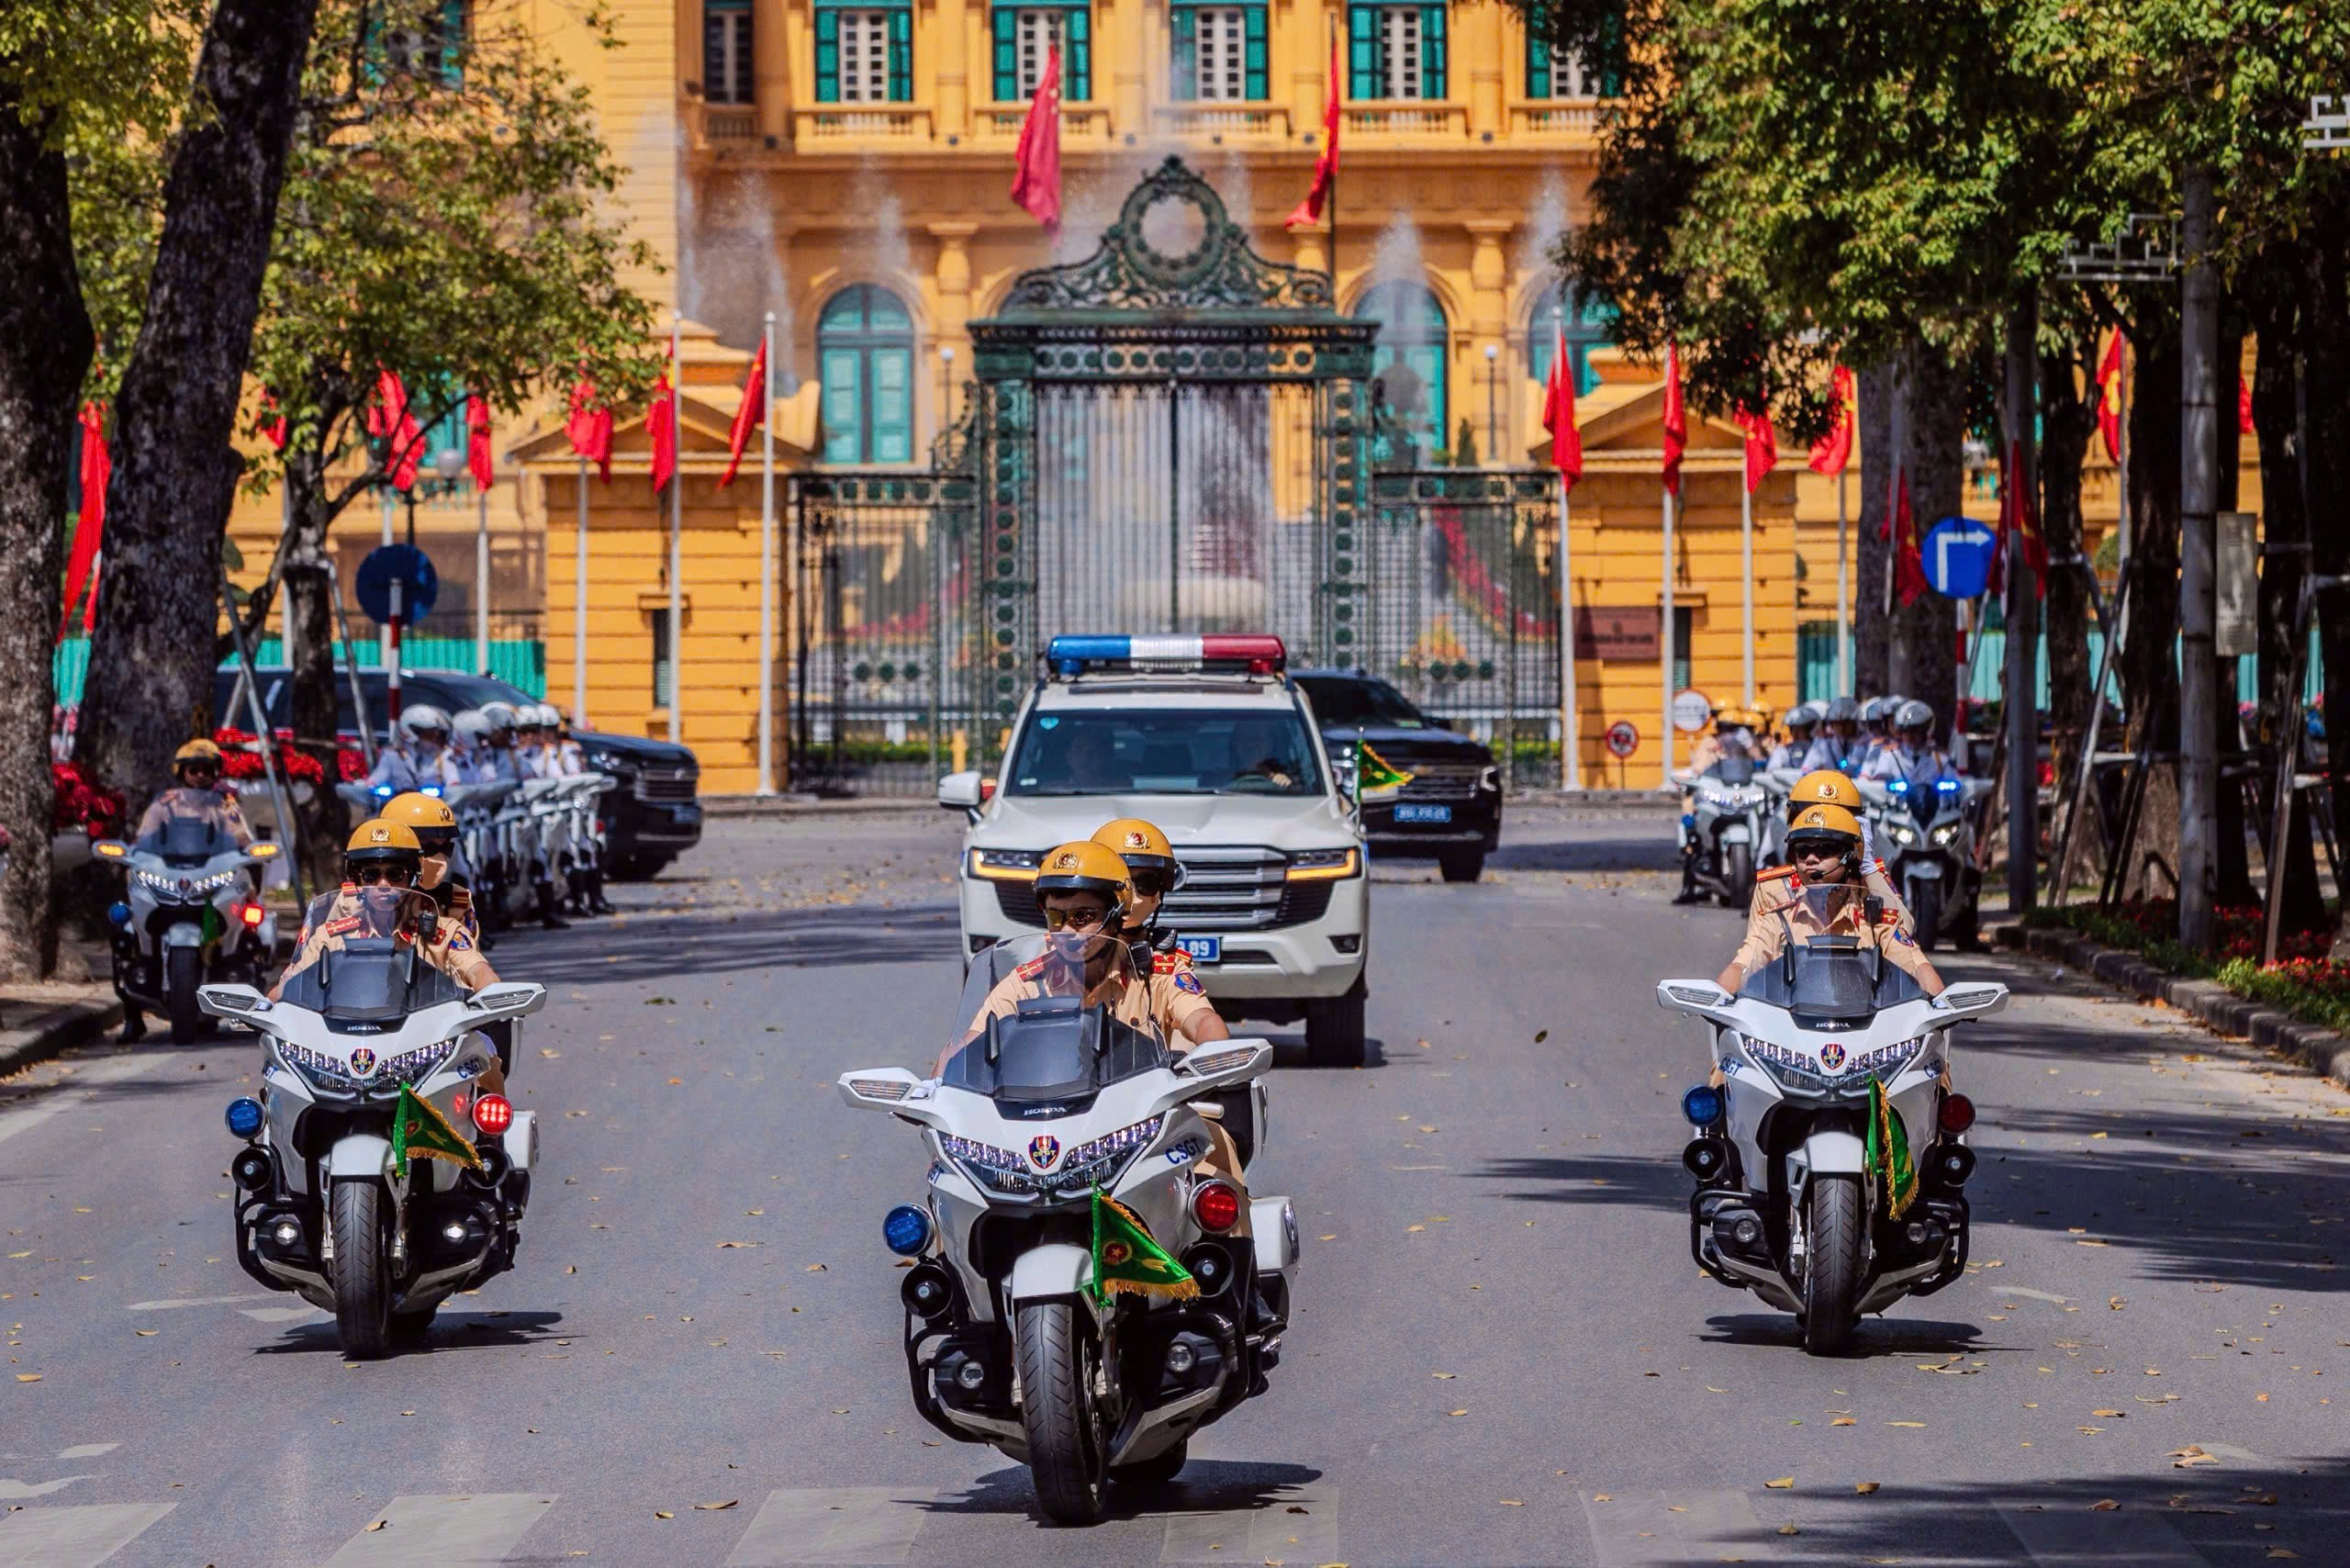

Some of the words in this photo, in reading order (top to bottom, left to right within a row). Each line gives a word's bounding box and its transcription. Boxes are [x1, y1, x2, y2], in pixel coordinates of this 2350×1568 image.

[1719, 1057, 1743, 1077] CSGT
[1024, 1106, 1068, 1115] HONDA
[1033, 1149, 1056, 1158] CSGT
[1165, 1137, 1202, 1165] CSGT
